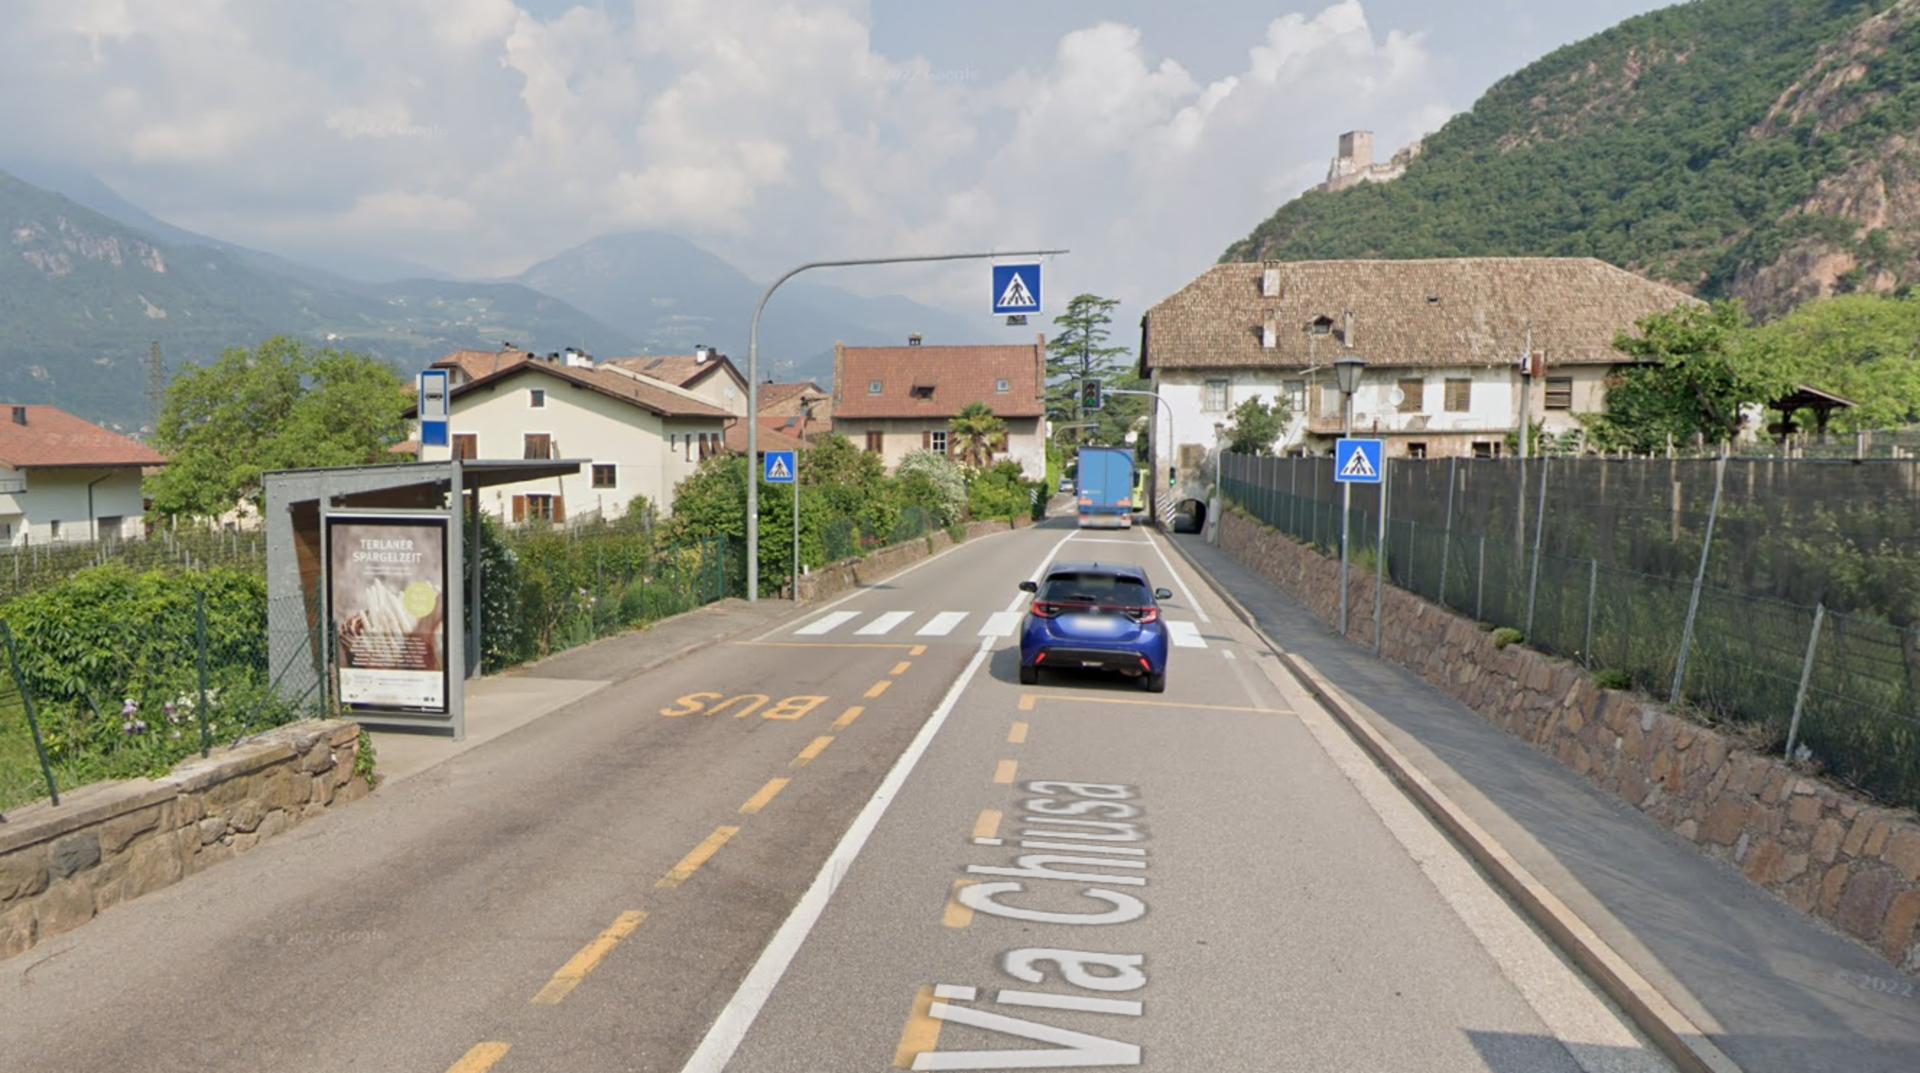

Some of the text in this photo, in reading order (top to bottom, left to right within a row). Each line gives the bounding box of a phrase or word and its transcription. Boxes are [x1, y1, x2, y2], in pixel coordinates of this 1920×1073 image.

[360, 539, 414, 551] TERLANER
[352, 551, 423, 563] SPARGELZEIT
[659, 692, 831, 721] BUS
